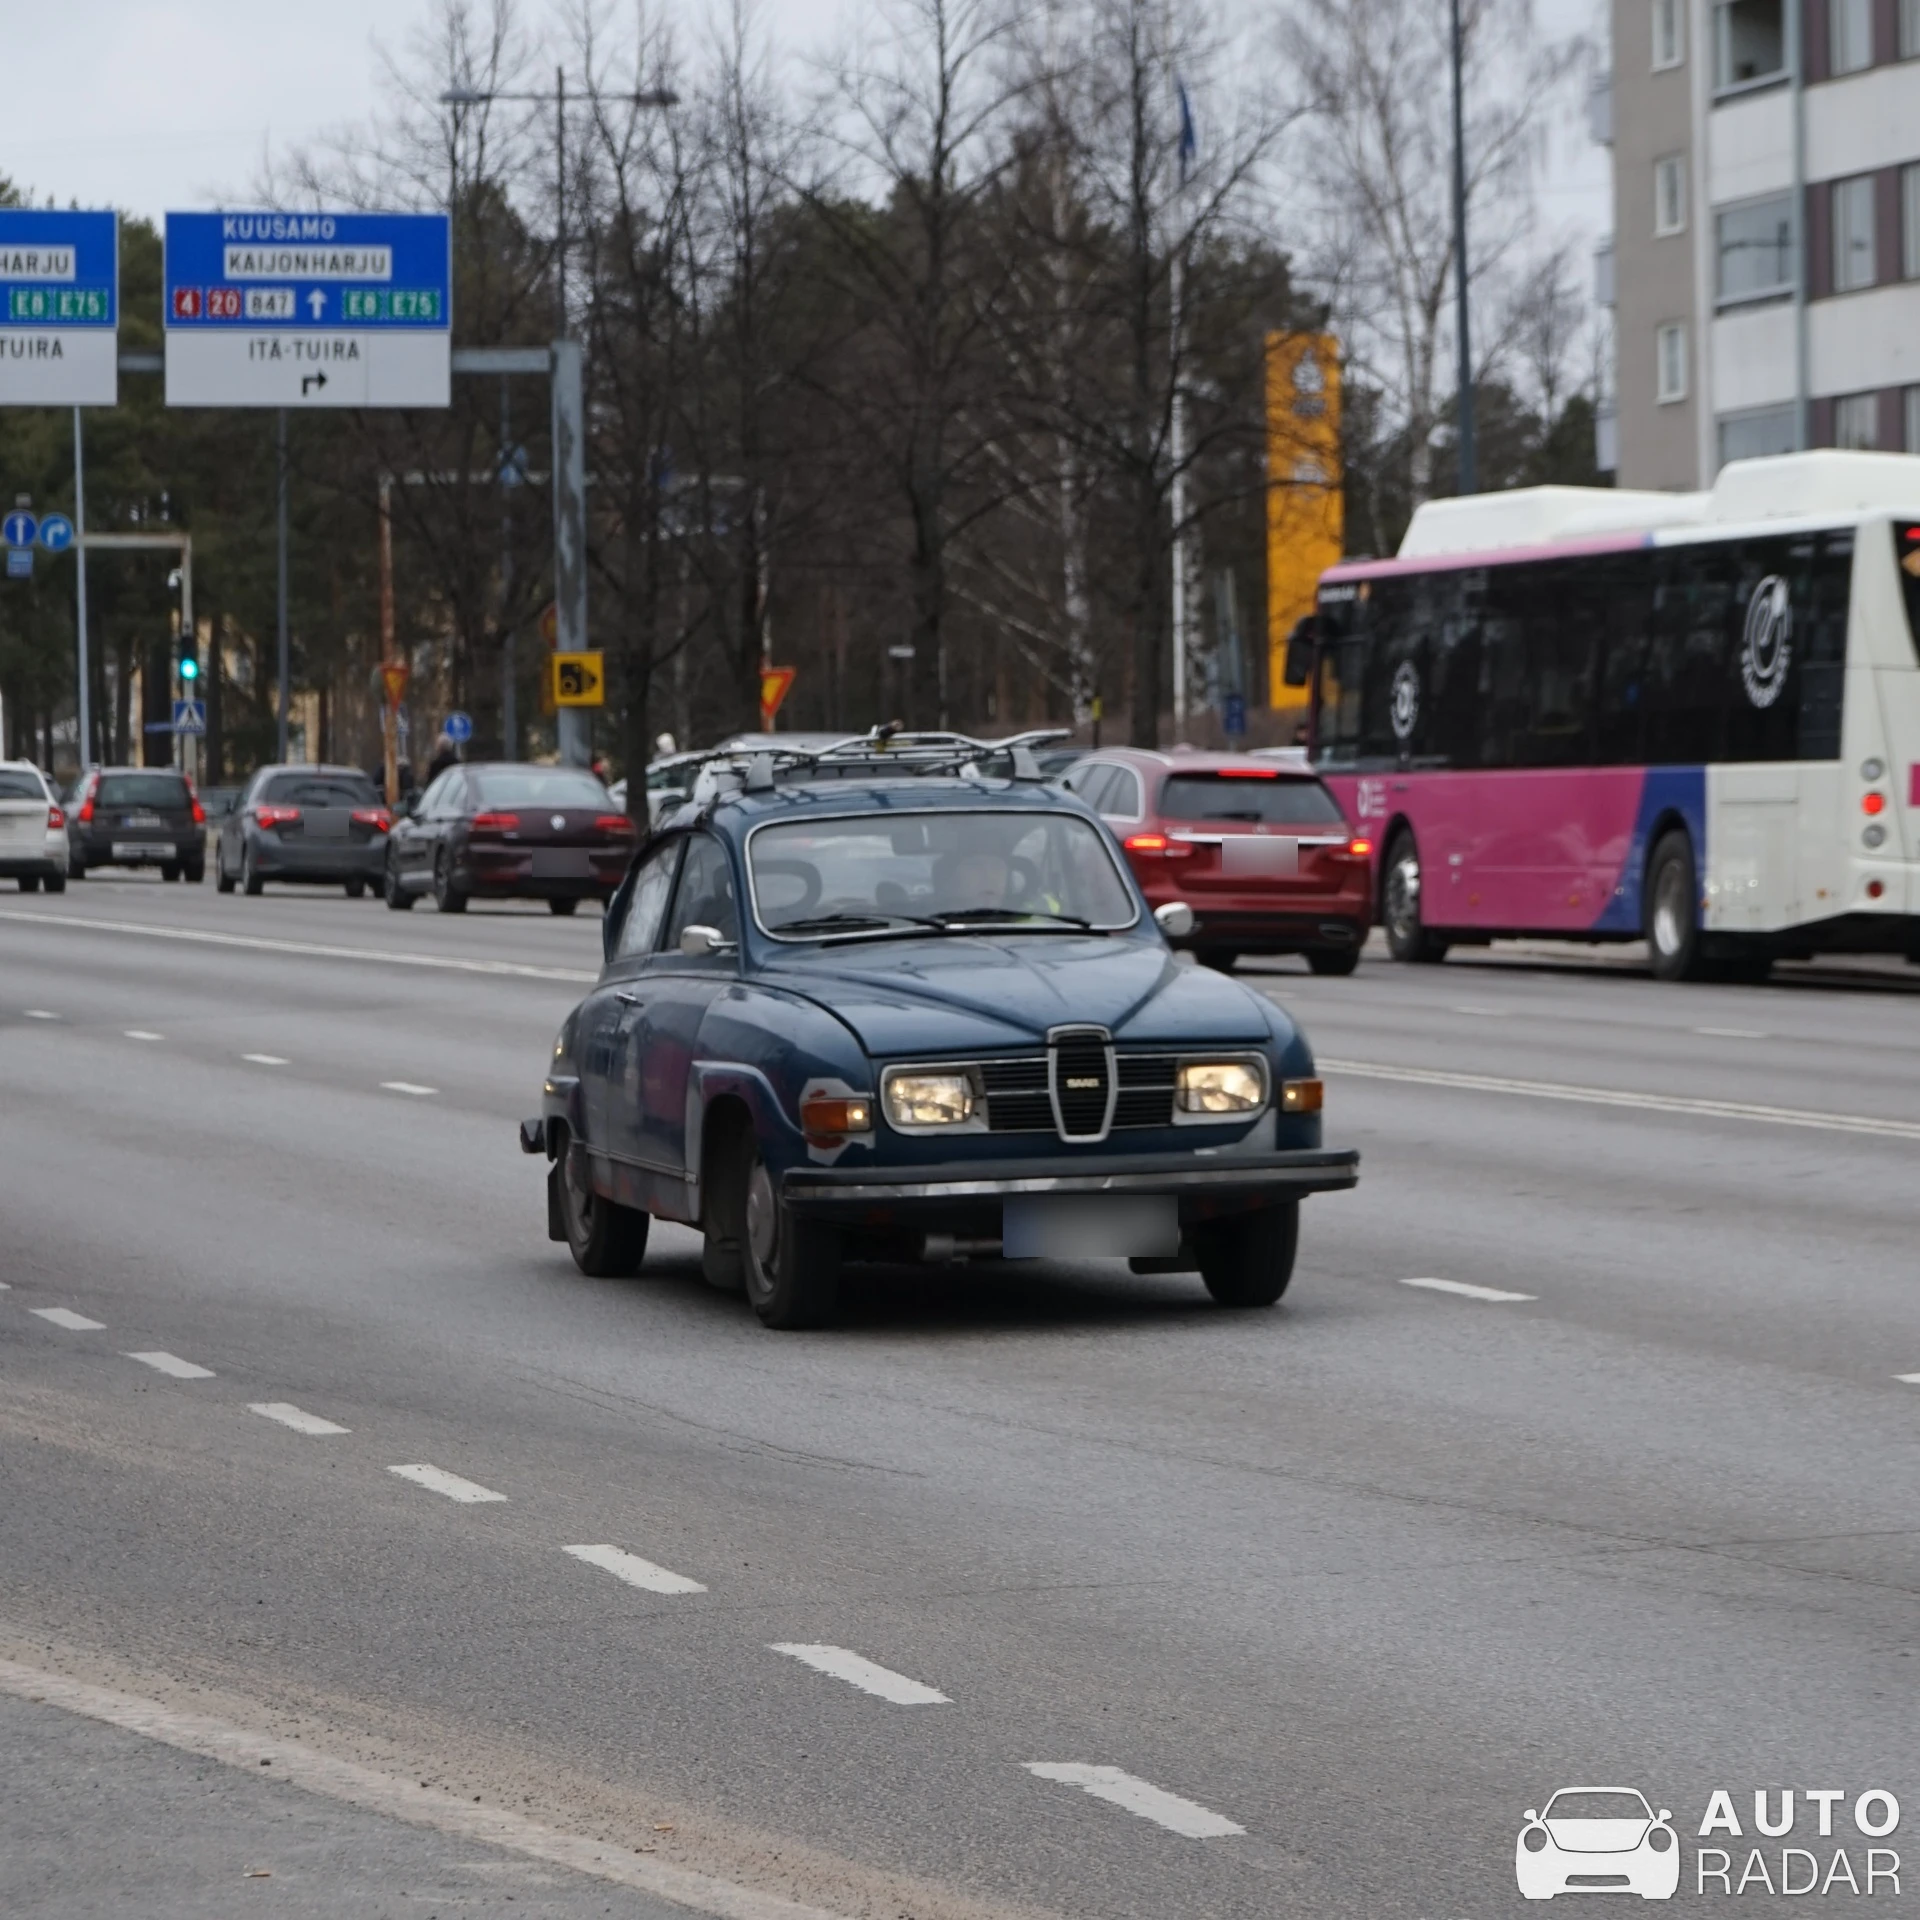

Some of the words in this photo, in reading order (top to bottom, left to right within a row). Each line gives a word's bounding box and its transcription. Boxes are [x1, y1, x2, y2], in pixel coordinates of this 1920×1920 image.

[223, 216, 336, 239] KUUSAMO
[229, 252, 386, 273] KAIJONHARJU
[17, 290, 44, 316] E8
[60, 290, 100, 316] E75
[179, 291, 193, 315] 4
[211, 290, 238, 315] 20
[349, 290, 377, 316] E8
[392, 290, 433, 316] E75
